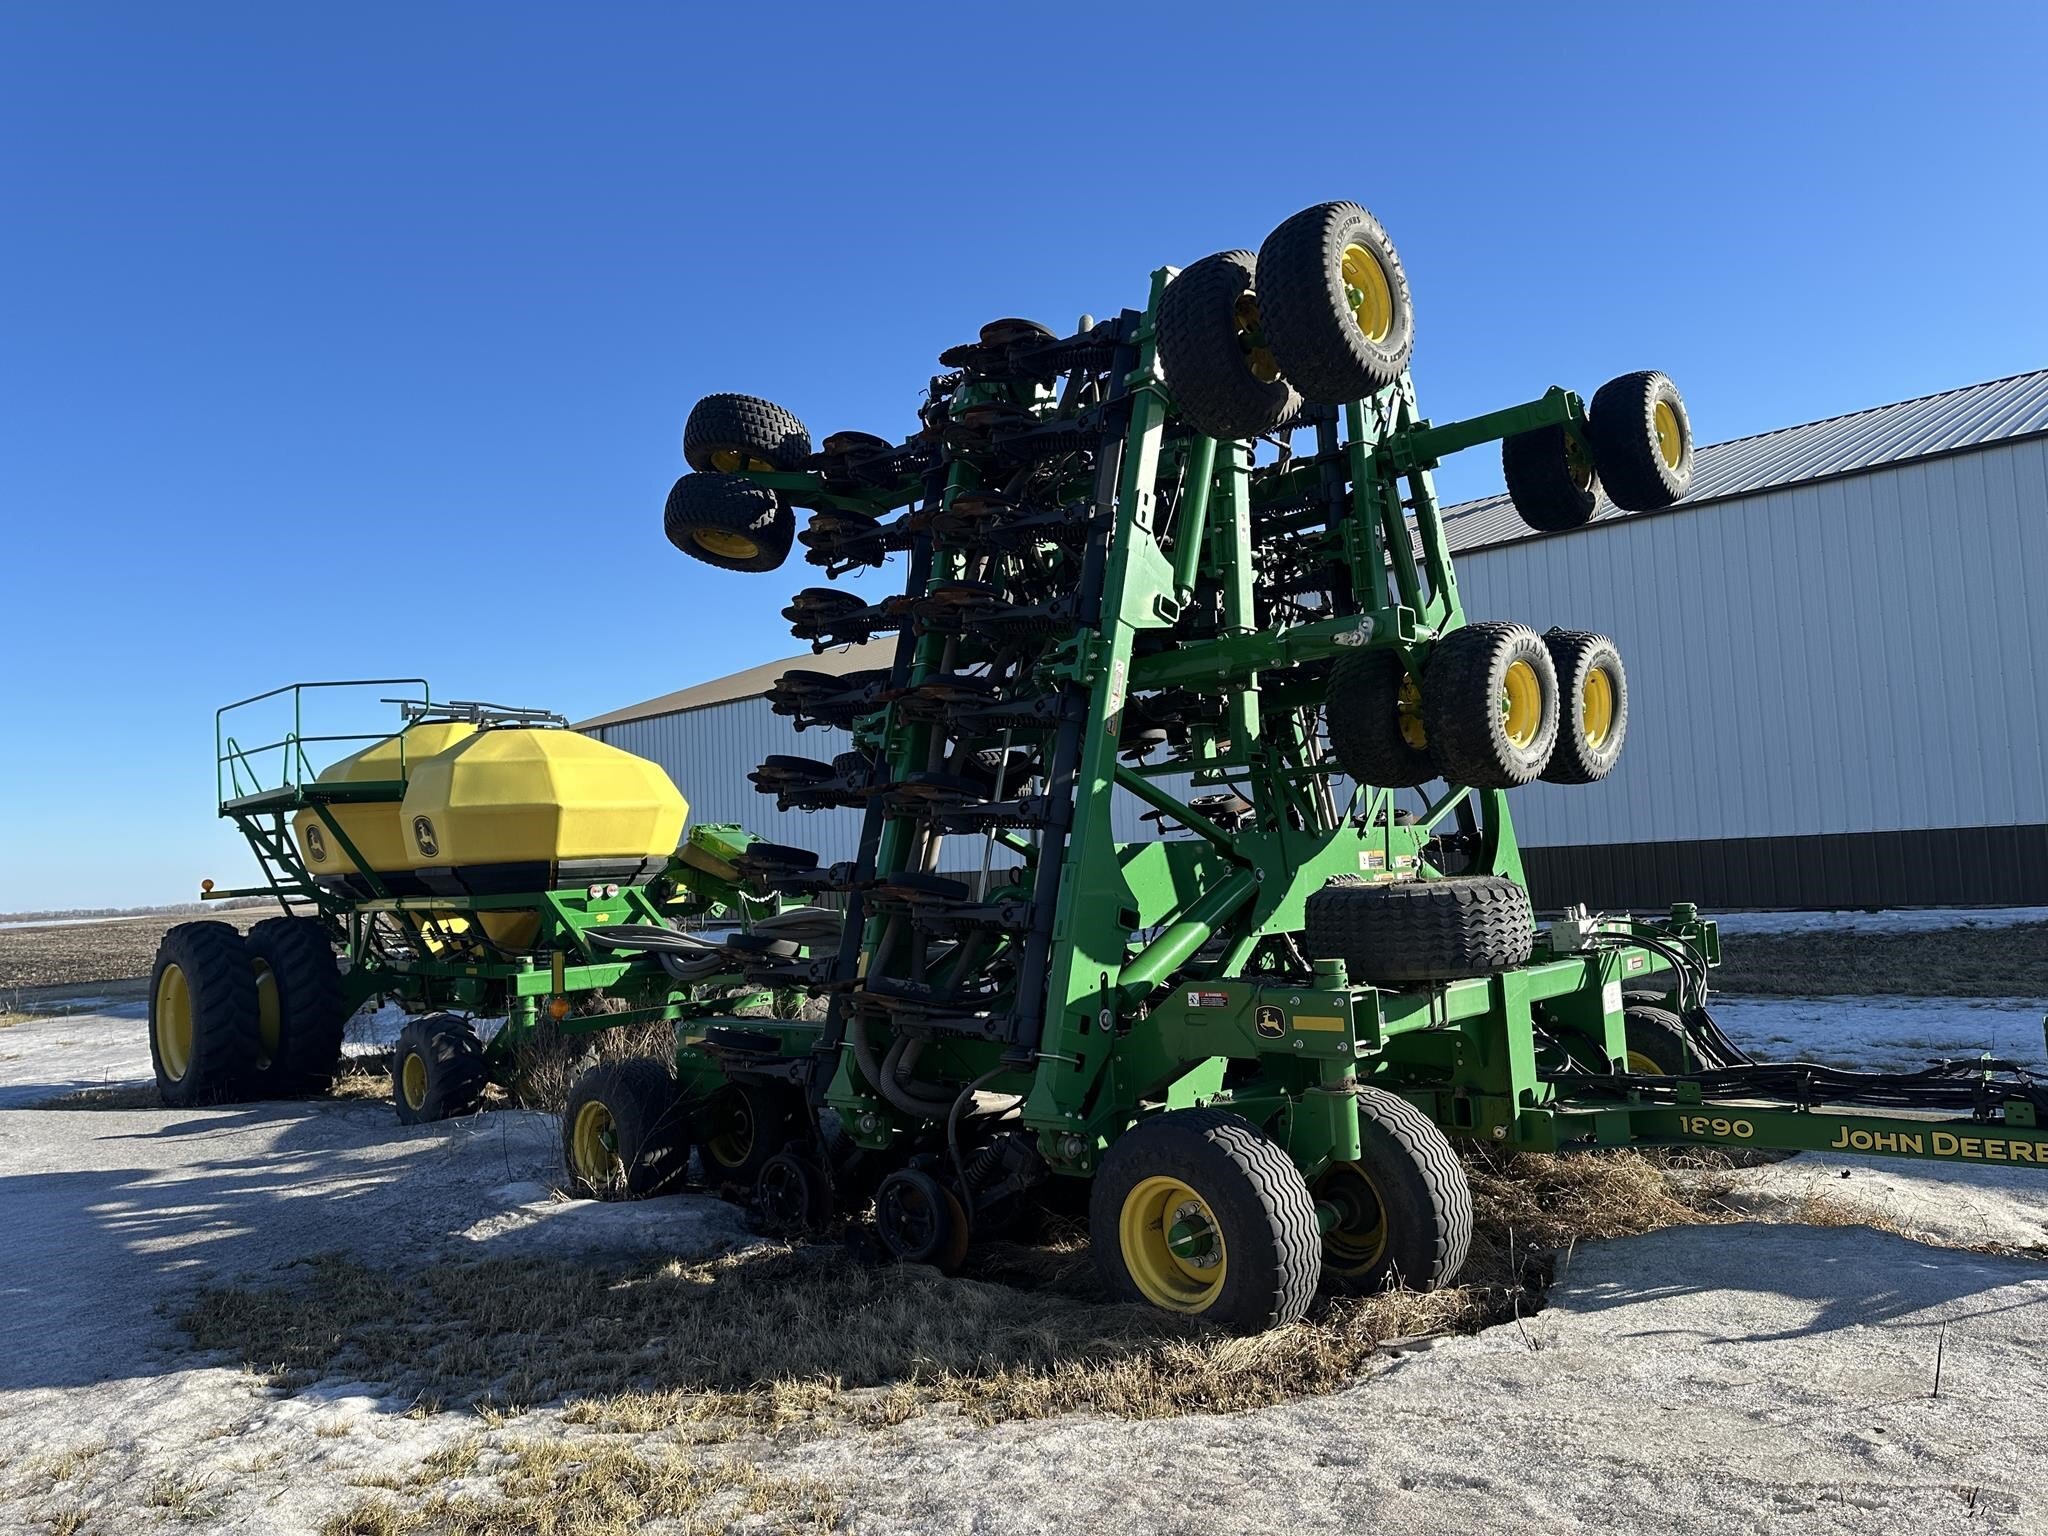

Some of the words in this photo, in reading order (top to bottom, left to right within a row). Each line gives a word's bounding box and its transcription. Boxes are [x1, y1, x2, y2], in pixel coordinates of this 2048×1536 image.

[1380, 233, 1411, 305] TITAN
[1512, 637, 1546, 660] TITAN
[1679, 1115, 1754, 1138] 1890
[1831, 1125, 1924, 1154] JOHN
[1931, 1131, 2048, 1163] DEERE
